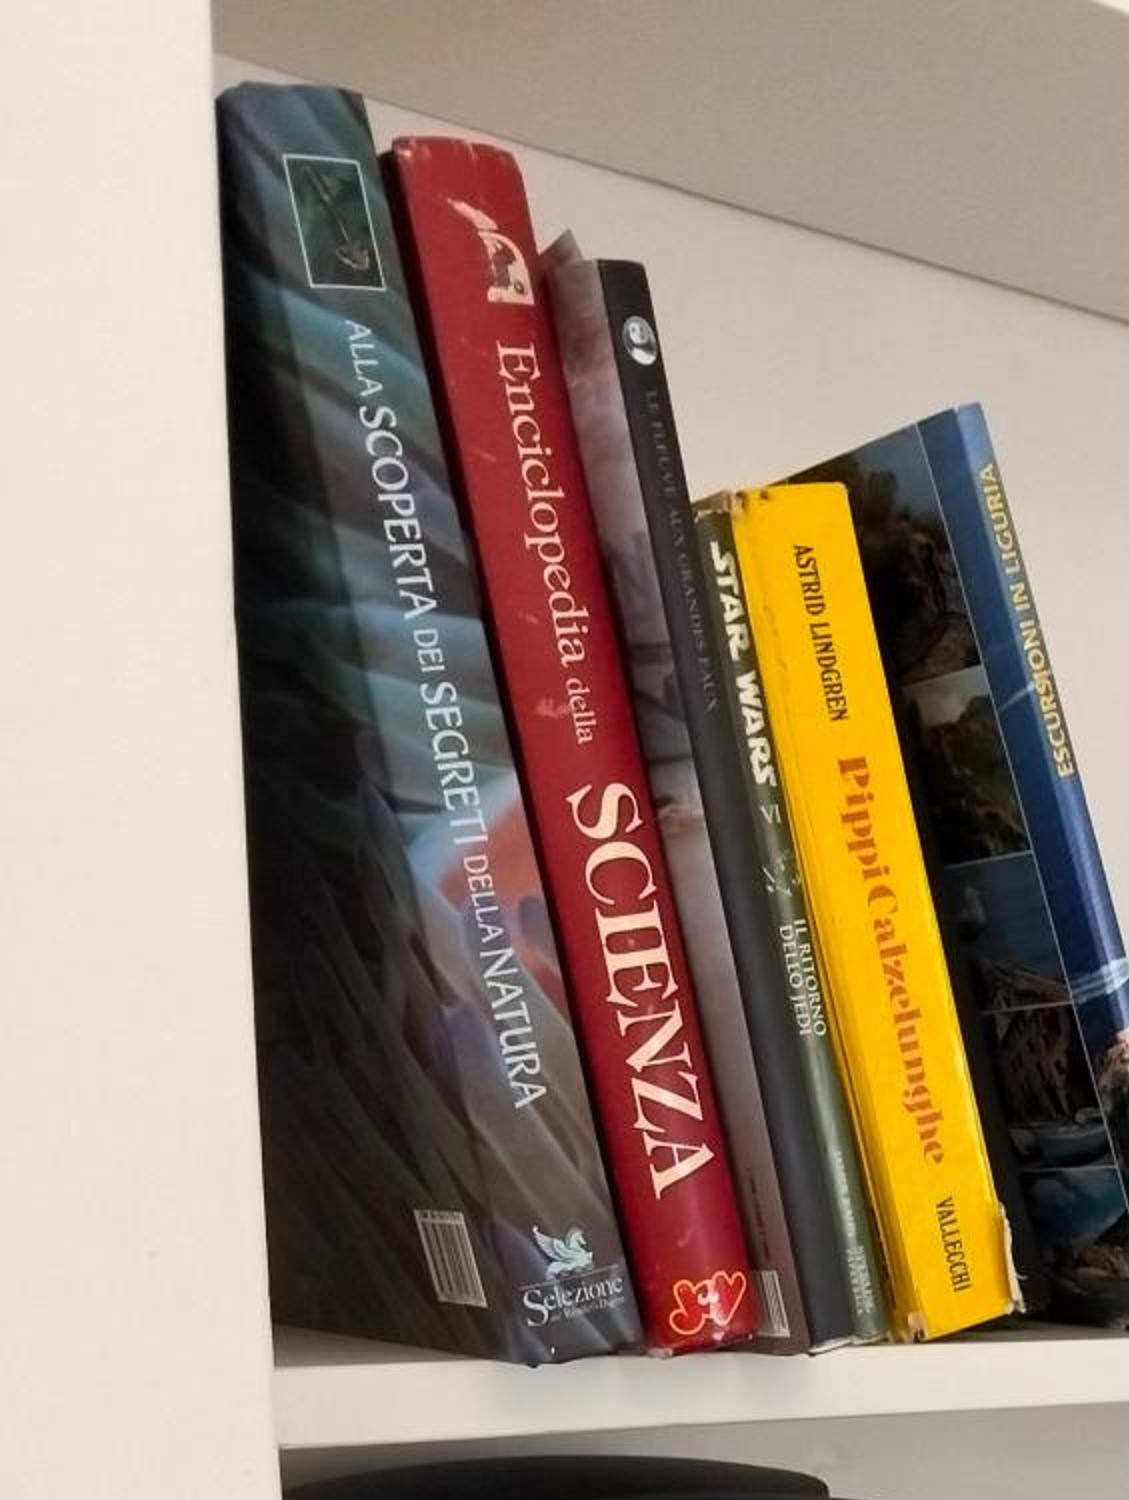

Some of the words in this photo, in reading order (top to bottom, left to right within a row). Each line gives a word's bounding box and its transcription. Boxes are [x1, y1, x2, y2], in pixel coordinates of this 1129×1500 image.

[344, 319, 383, 397] ALLA
[359, 405, 437, 620] SCOPERTA
[496, 341, 589, 667] Enciclopedia
[979, 463, 1021, 574] LIGURIA
[793, 544, 827, 616] ASTRID
[1010, 581, 1031, 611] IN
[413, 628, 445, 672] DEI
[709, 540, 749, 661] STAR
[736, 669, 777, 787] WARS
[761, 803, 782, 825] VI
[809, 622, 850, 722] LINDGREN
[565, 677, 597, 744] della
[1020, 620, 1075, 777] ESCURSIONI
[420, 681, 488, 845] SEGRETI
[463, 855, 504, 943] DELLA
[794, 919, 808, 937] IL
[566, 782, 715, 1199] SCIENZA
[780, 925, 803, 989] DELLO
[798, 943, 827, 1036] RITORNO
[838, 755, 891, 882] Pippi
[867, 885, 945, 1166] Calzelunghe
[480, 947, 547, 1109] NATURA
[789, 995, 813, 1036] JEDI
[936, 1196, 974, 1293] VALLECCHI
[523, 1277, 623, 1327] Selezione
